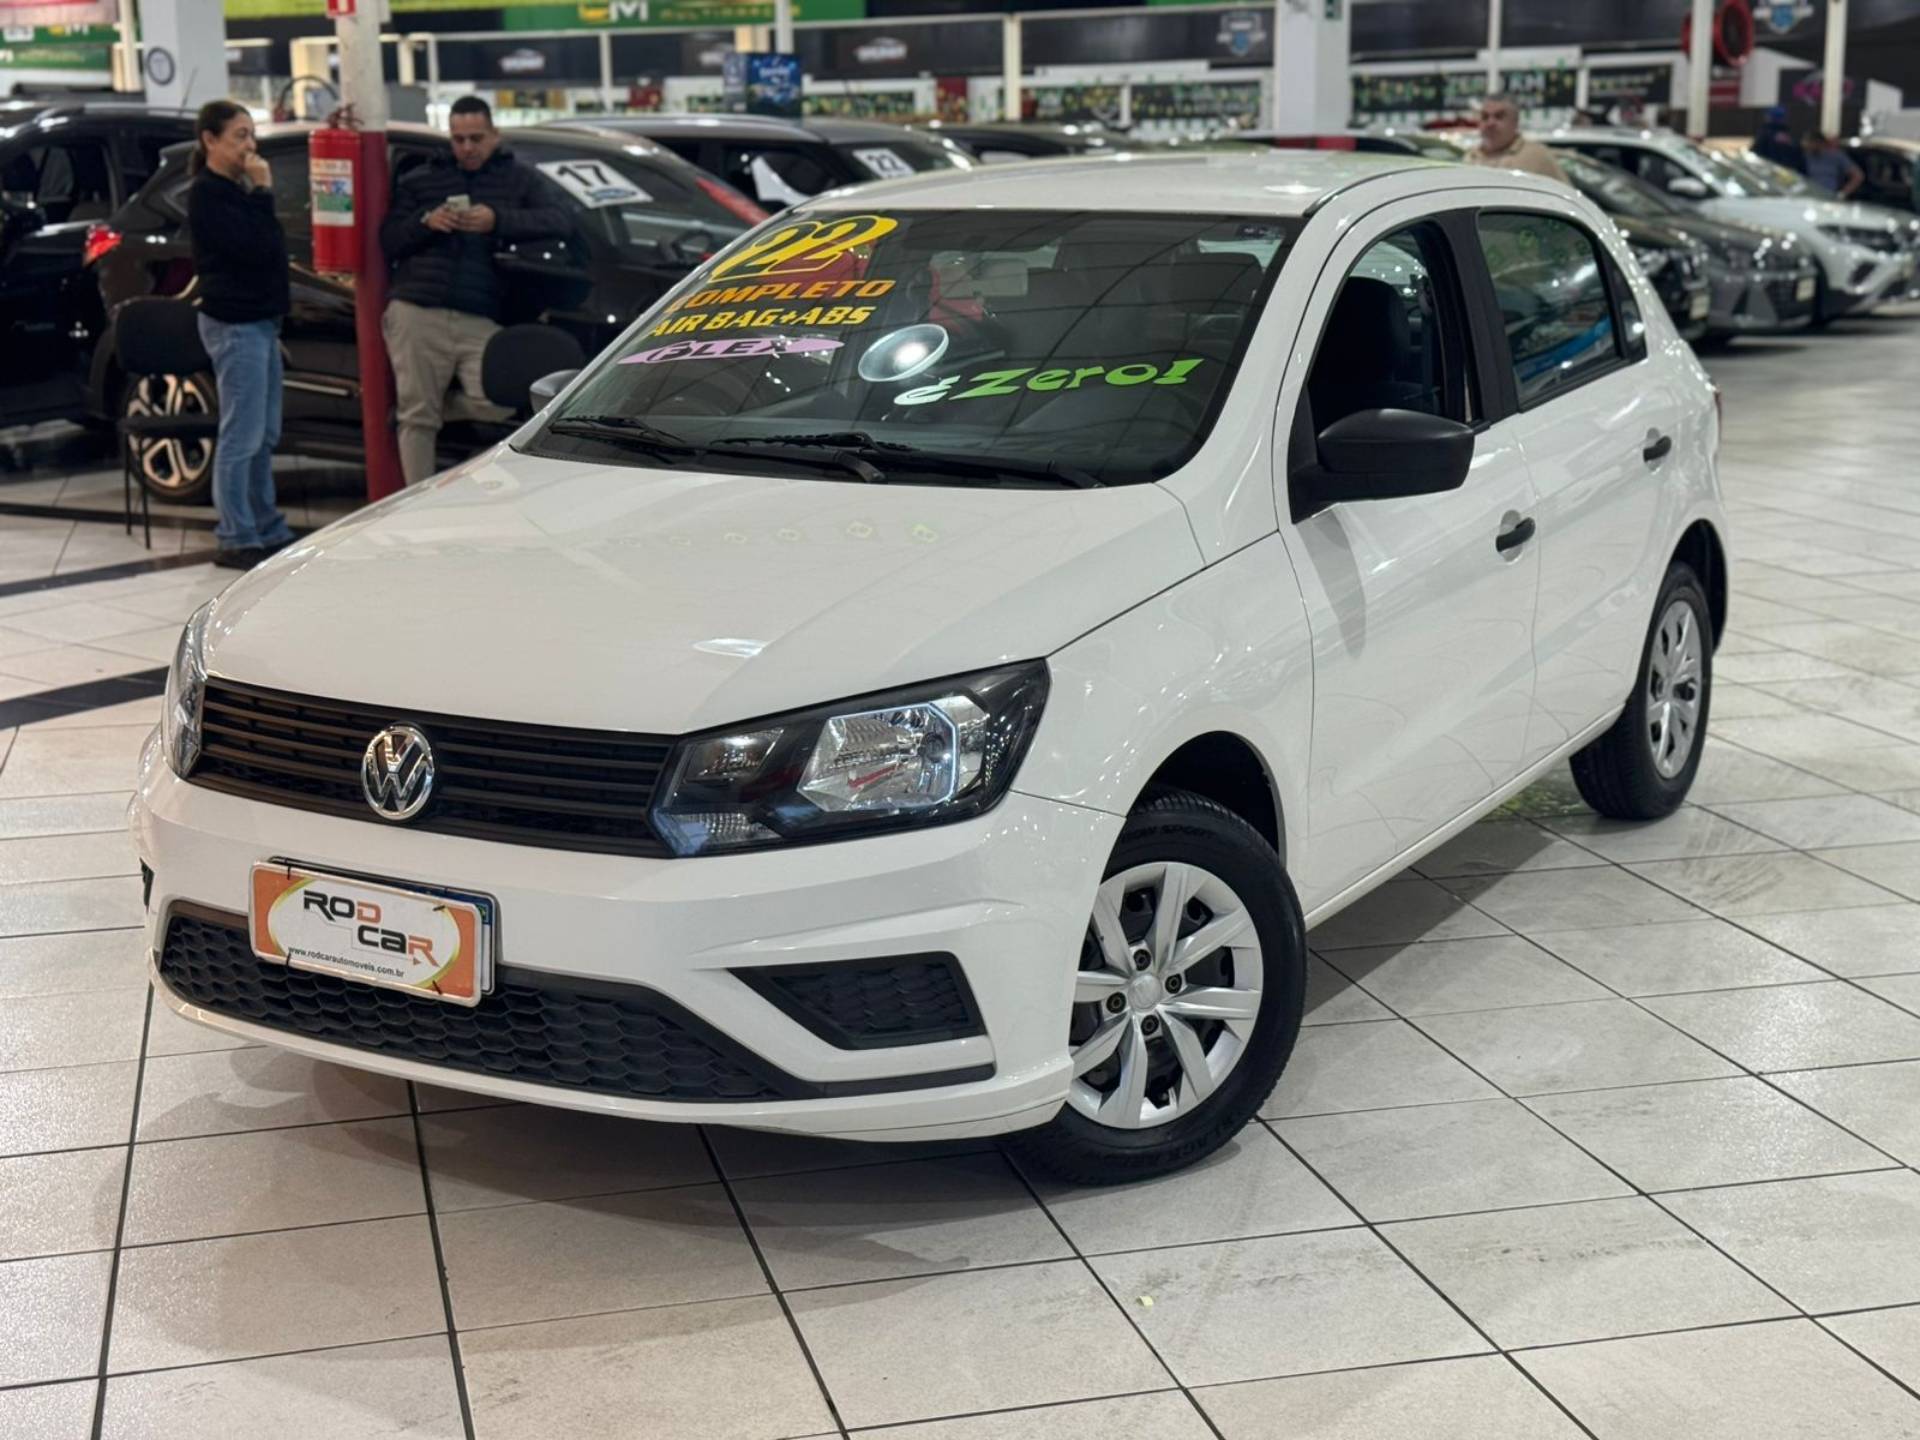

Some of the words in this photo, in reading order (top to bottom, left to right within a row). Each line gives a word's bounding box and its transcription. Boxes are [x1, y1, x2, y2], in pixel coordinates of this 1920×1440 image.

[557, 164, 609, 187] 17
[706, 215, 898, 284] 22
[650, 313, 707, 338] AIR
[303, 889, 382, 924] ROD
[287, 946, 405, 978] www.rodcarautomoveis.com.br
